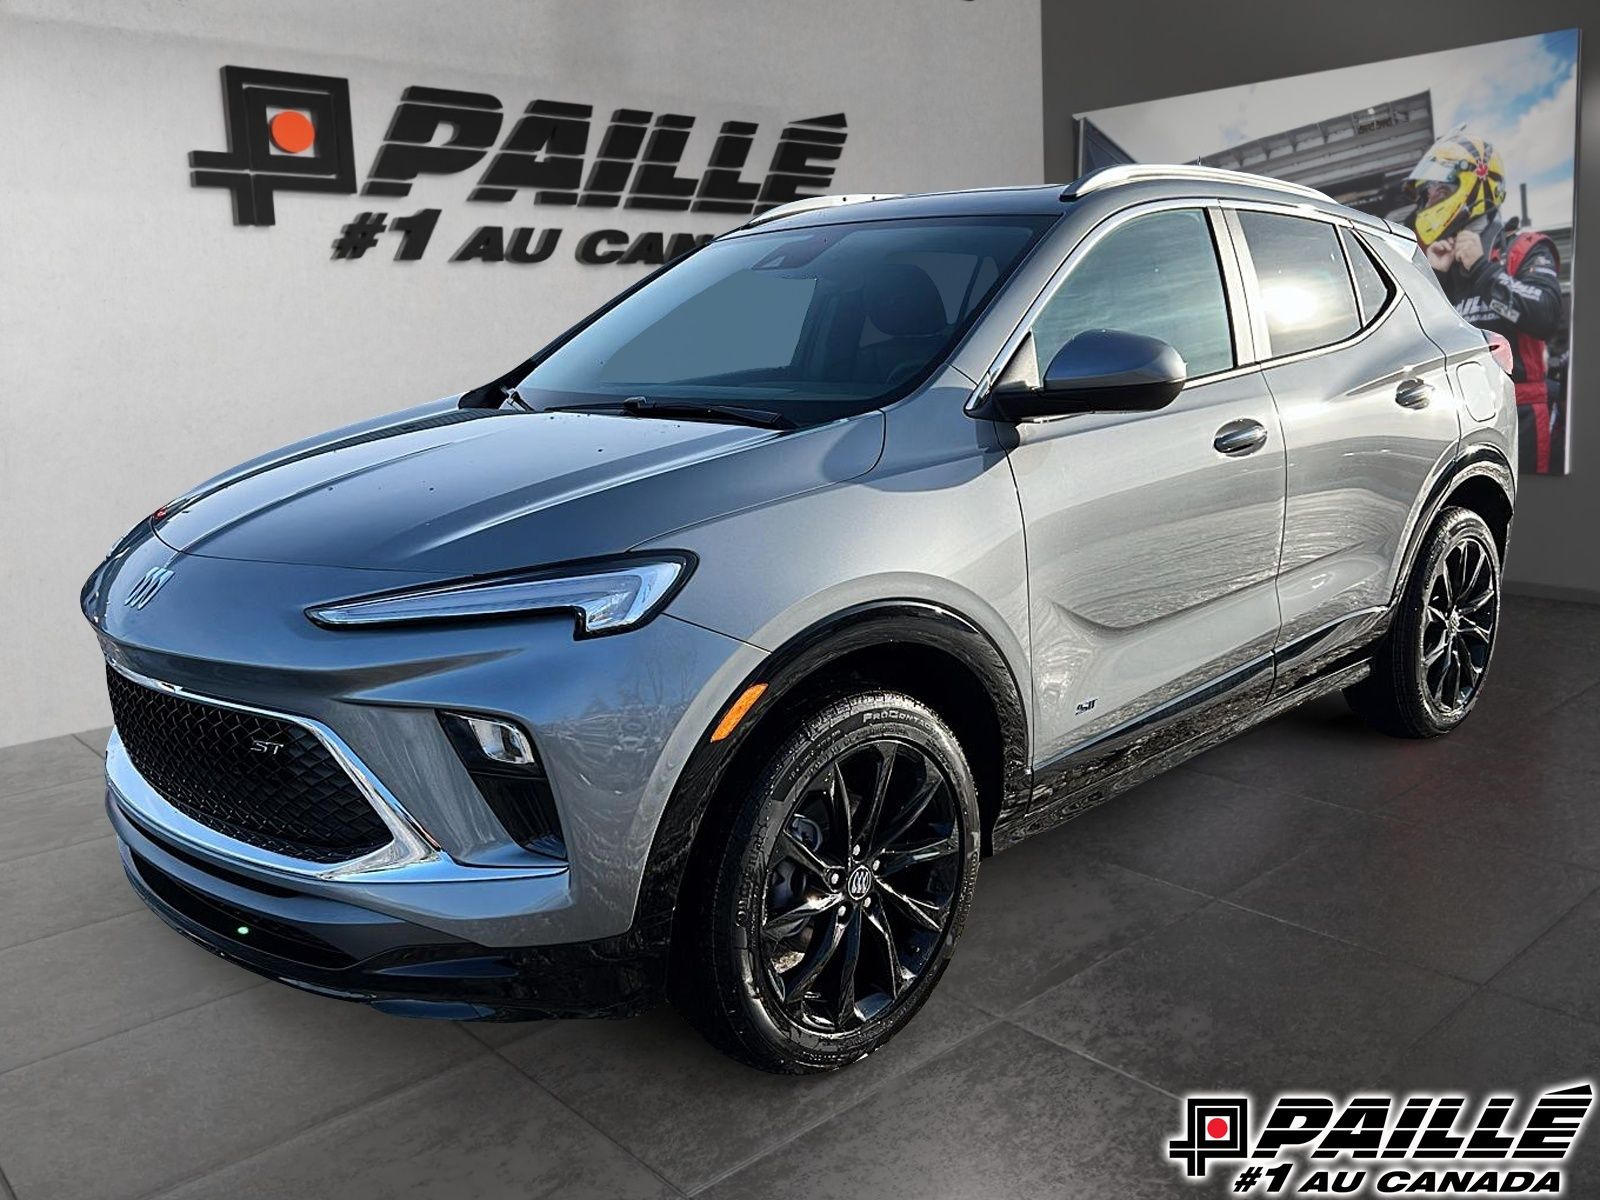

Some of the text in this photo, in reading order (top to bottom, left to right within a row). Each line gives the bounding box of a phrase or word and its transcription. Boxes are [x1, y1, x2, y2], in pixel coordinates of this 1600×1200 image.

[360, 85, 848, 215] PAILLÉ
[330, 208, 442, 261] #1
[448, 226, 563, 263] AU
[250, 739, 284, 755] ST
